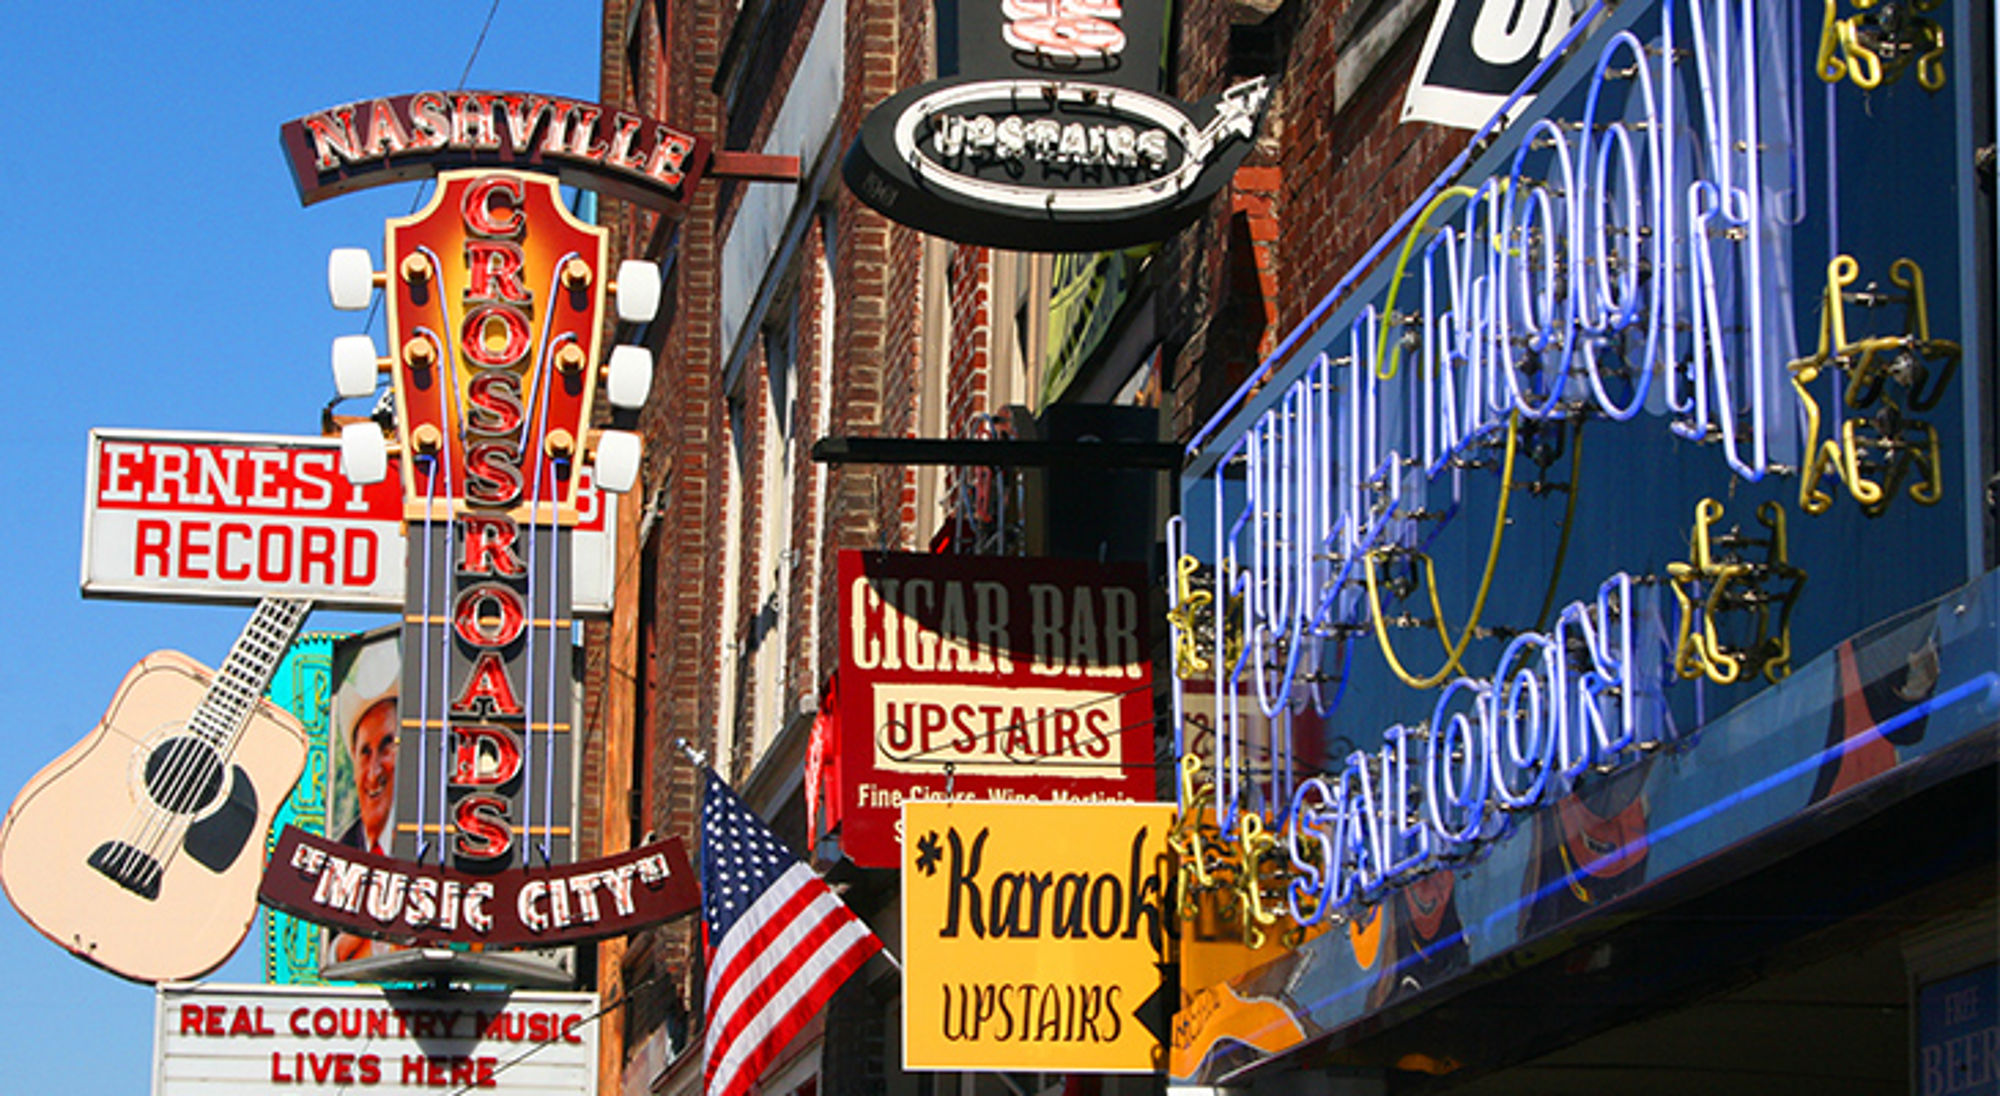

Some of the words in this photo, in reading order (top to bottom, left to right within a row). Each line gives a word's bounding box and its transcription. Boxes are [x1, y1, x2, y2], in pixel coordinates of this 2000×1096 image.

[303, 92, 695, 191] NASHVILLE
[934, 113, 1168, 171] UPSTAIRS
[447, 174, 532, 860] CROSSROADS
[134, 518, 379, 587] RECORD
[851, 575, 1015, 675] CIGAR
[1029, 582, 1143, 679] BAR
[886, 701, 1112, 758] UPSTAIRS
[1289, 571, 1632, 927] SALOON
[857, 782, 902, 808] Fine
[180, 1004, 275, 1038] REAL
[289, 1006, 467, 1041] COUNTRY
[478, 1011, 583, 1045] MUSIC
[942, 982, 1124, 1043] UPSTAIRS
[271, 1051, 382, 1085] LIVES
[401, 1054, 498, 1088] HERE
